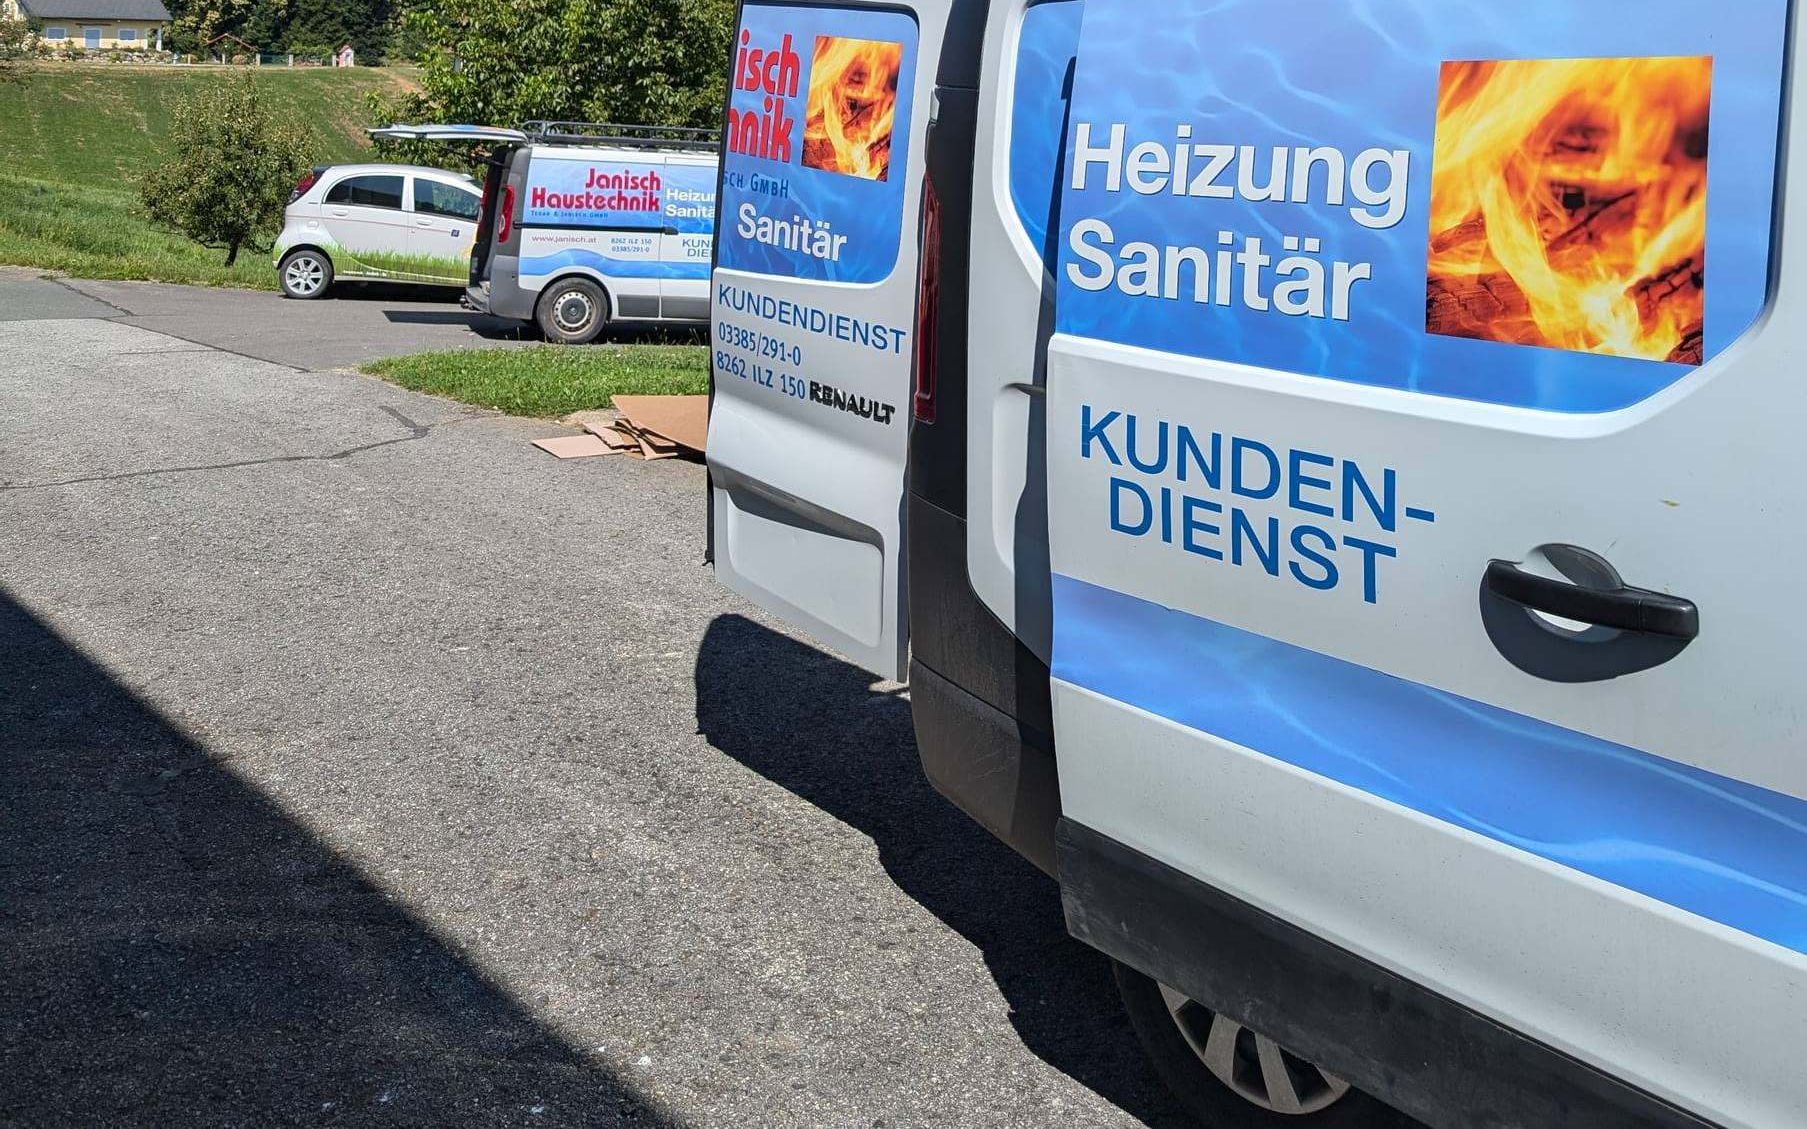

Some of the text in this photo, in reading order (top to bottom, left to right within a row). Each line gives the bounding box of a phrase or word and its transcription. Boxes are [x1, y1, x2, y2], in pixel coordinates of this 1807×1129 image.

[531, 187, 660, 211] Haustechnik
[585, 168, 661, 191] Janisch
[1071, 122, 1411, 228] Heizung
[531, 235, 598, 244] www.janisch.at
[737, 202, 847, 262] Sanitär
[1066, 218, 1372, 322] Sanitär
[718, 321, 801, 366] 03385/291-0
[719, 283, 907, 354] KUNDENDIENST
[716, 350, 806, 400] 8262 ILZ 150
[809, 380, 896, 426] RENAULT
[1081, 404, 1436, 533] KUNDEN-
[1109, 477, 1398, 605] DIENST
